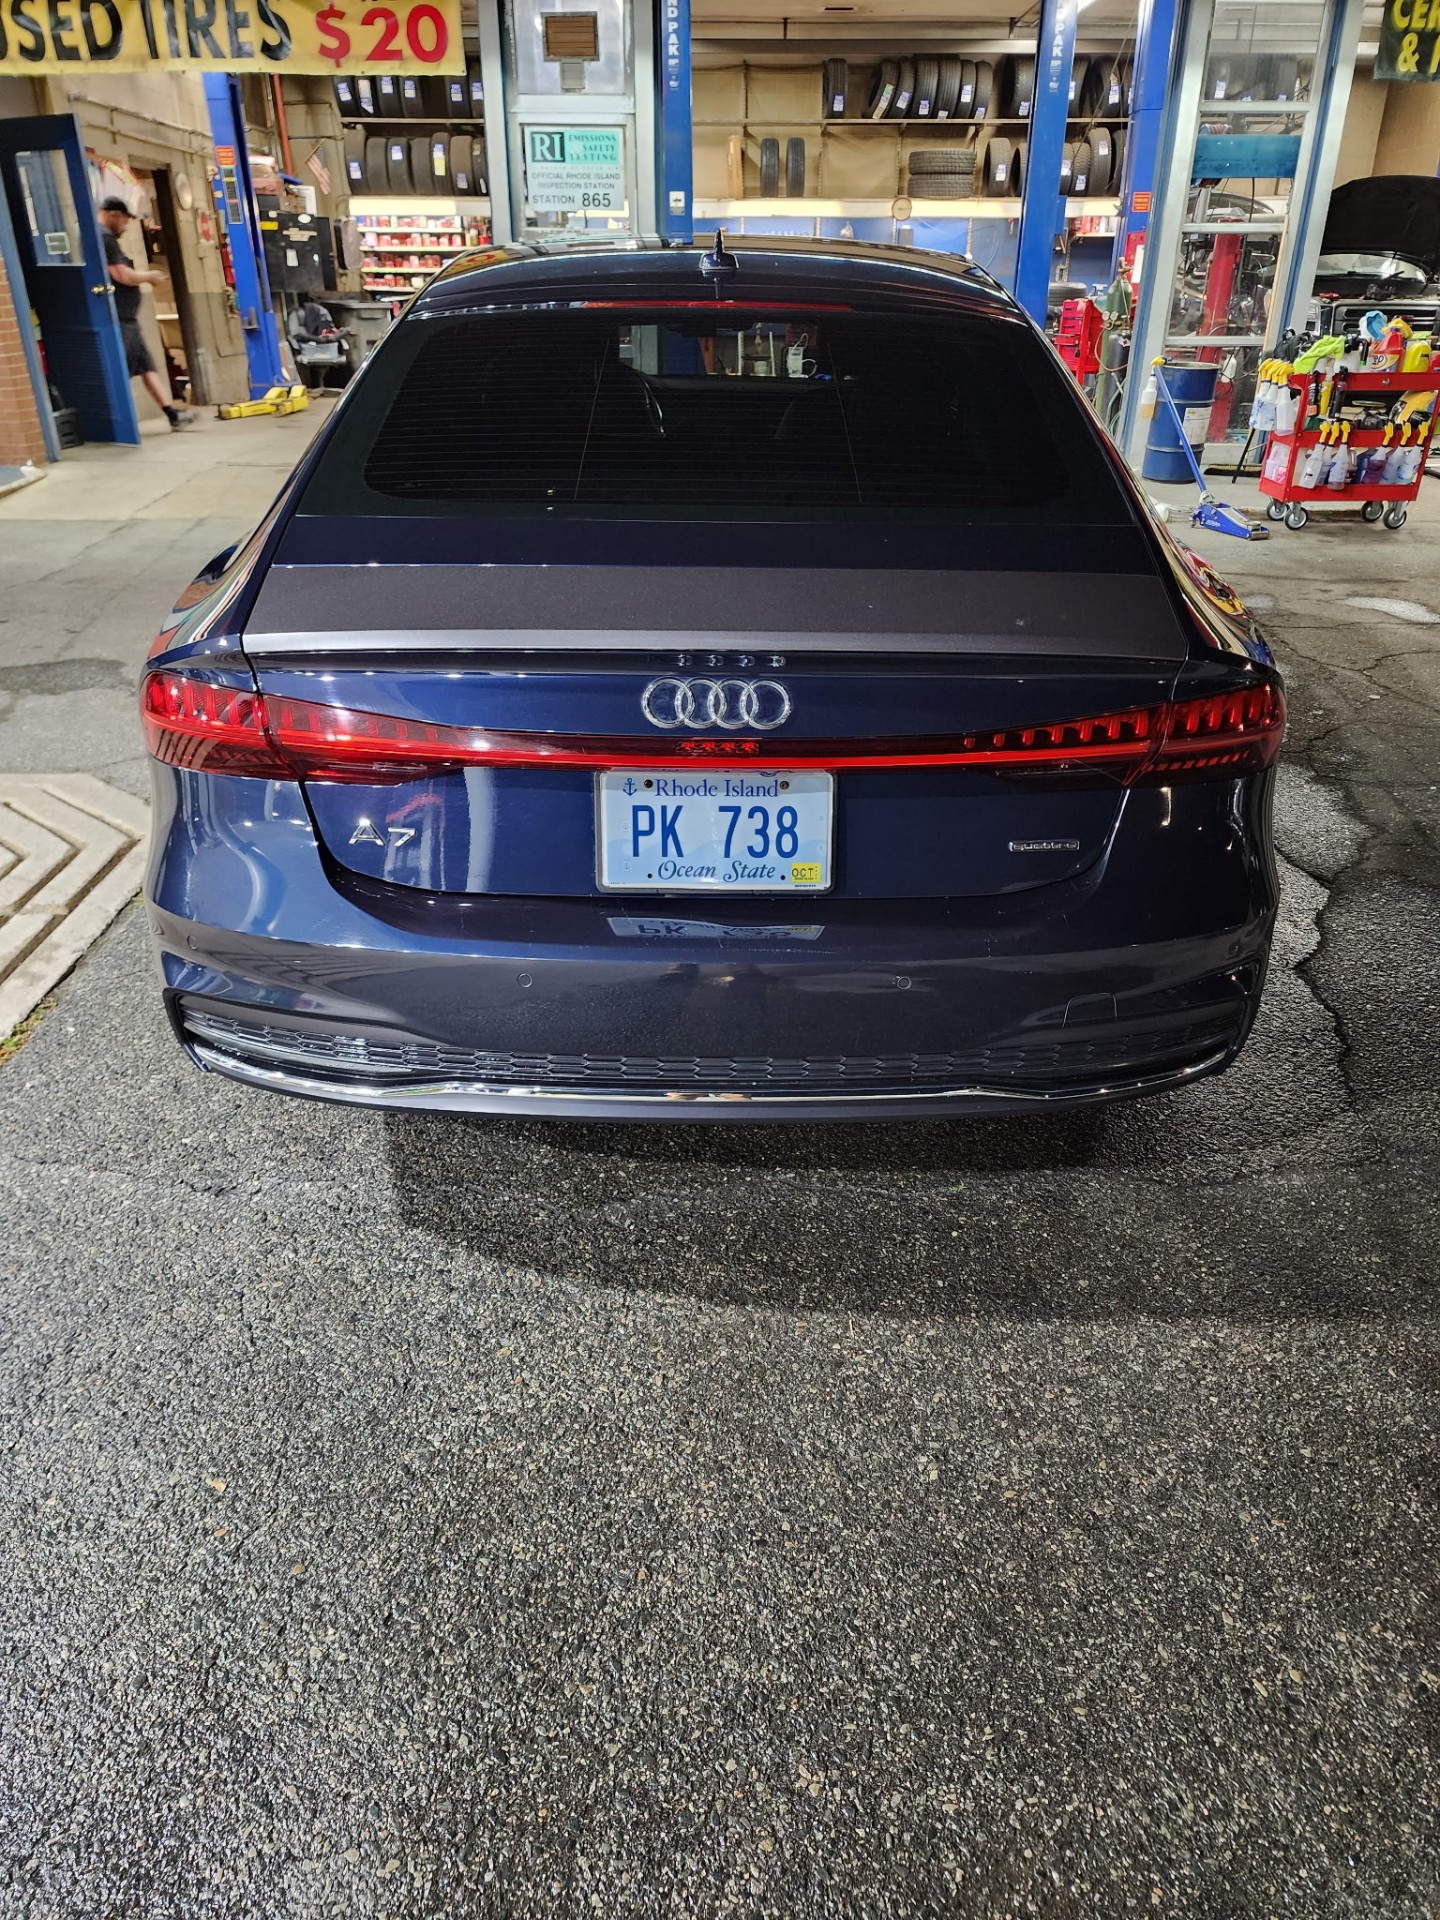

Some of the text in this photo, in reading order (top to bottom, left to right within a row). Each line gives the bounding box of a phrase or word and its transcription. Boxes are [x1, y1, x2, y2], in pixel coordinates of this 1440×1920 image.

[130, 0, 292, 61] TIRES
[1398, 32, 1420, 74] &
[568, 134, 617, 142] EMISSIONS
[531, 133, 565, 162] RI
[582, 144, 615, 152] SAFETY
[570, 153, 617, 161] TESTING
[531, 172, 564, 180] OFFICIAL
[538, 182, 615, 190] INSPECTION STATION
[532, 192, 611, 208] STATION 865
[653, 779, 780, 797] Rhode Island
[348, 817, 416, 847] A7
[631, 804, 799, 859] PK 738
[657, 860, 776, 882] Ocean State
[791, 867, 814, 878] OCT
